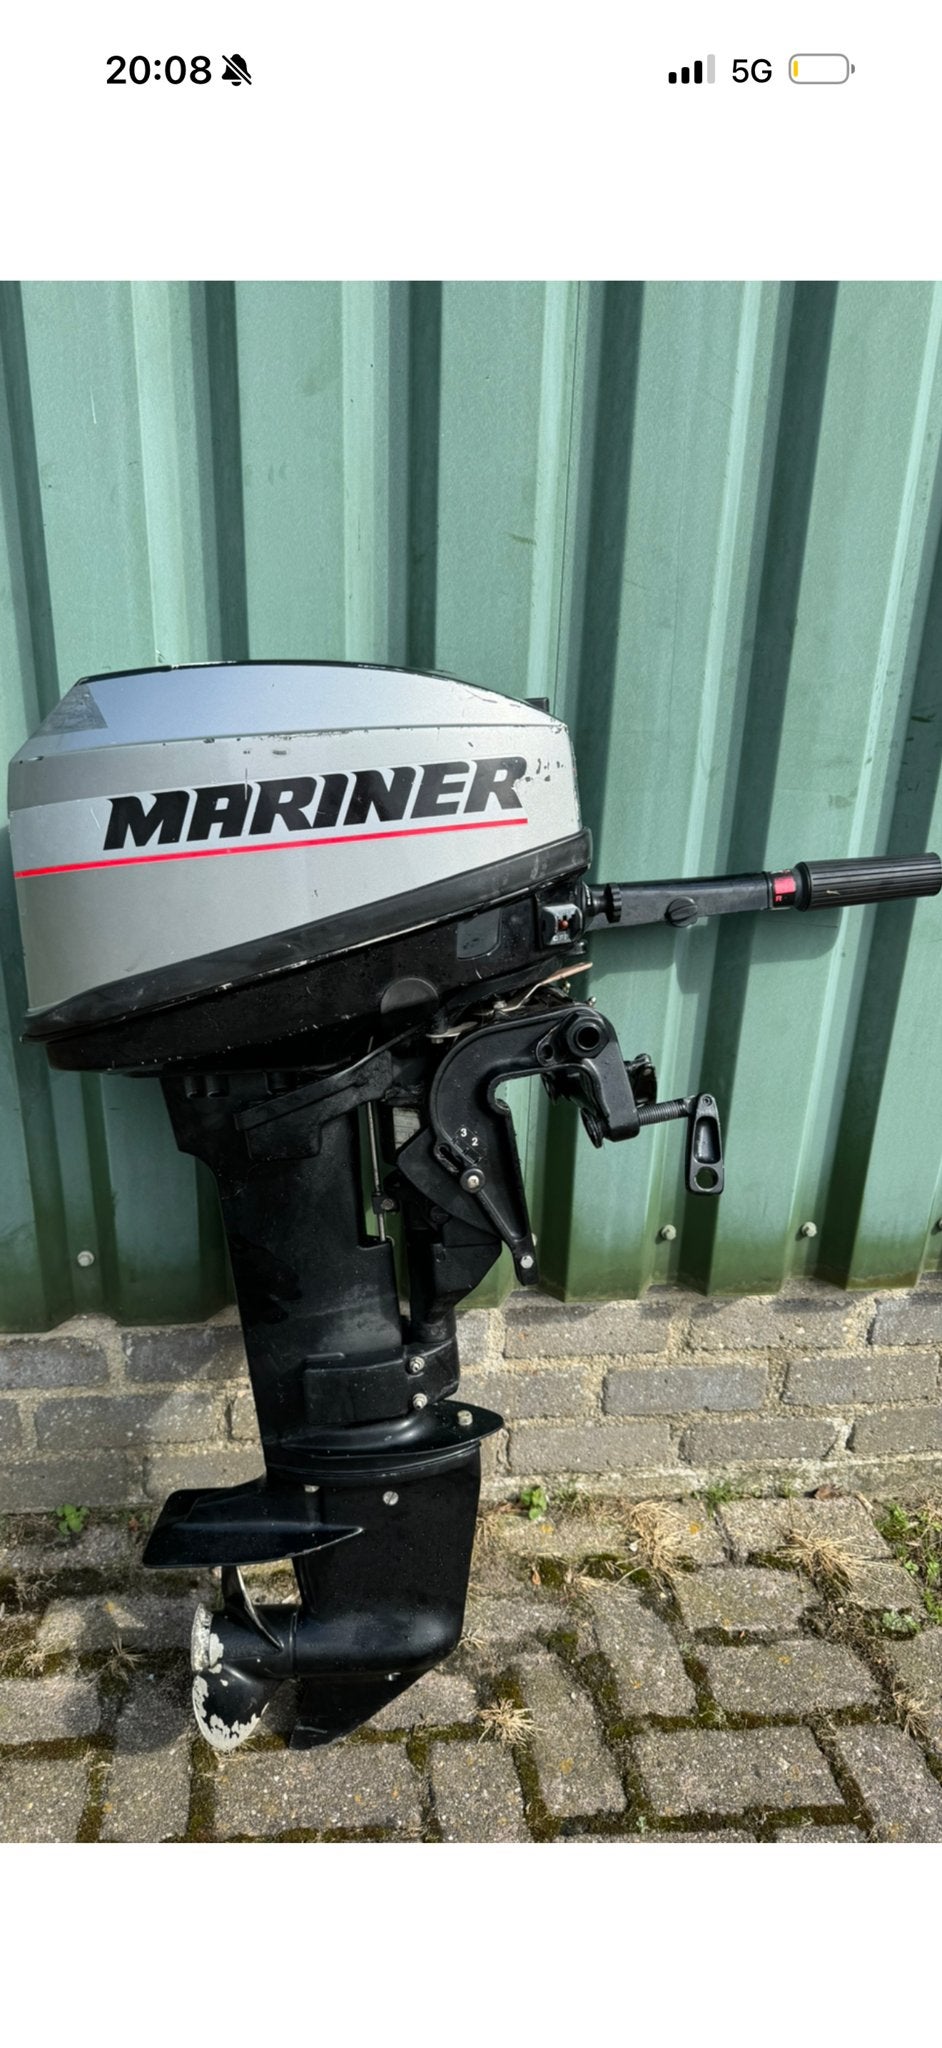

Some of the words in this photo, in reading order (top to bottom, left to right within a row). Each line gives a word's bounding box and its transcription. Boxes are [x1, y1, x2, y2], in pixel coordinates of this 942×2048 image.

[103, 756, 527, 850] MARINER
[460, 1127, 468, 1138] 3
[471, 1136, 479, 1147] 2
